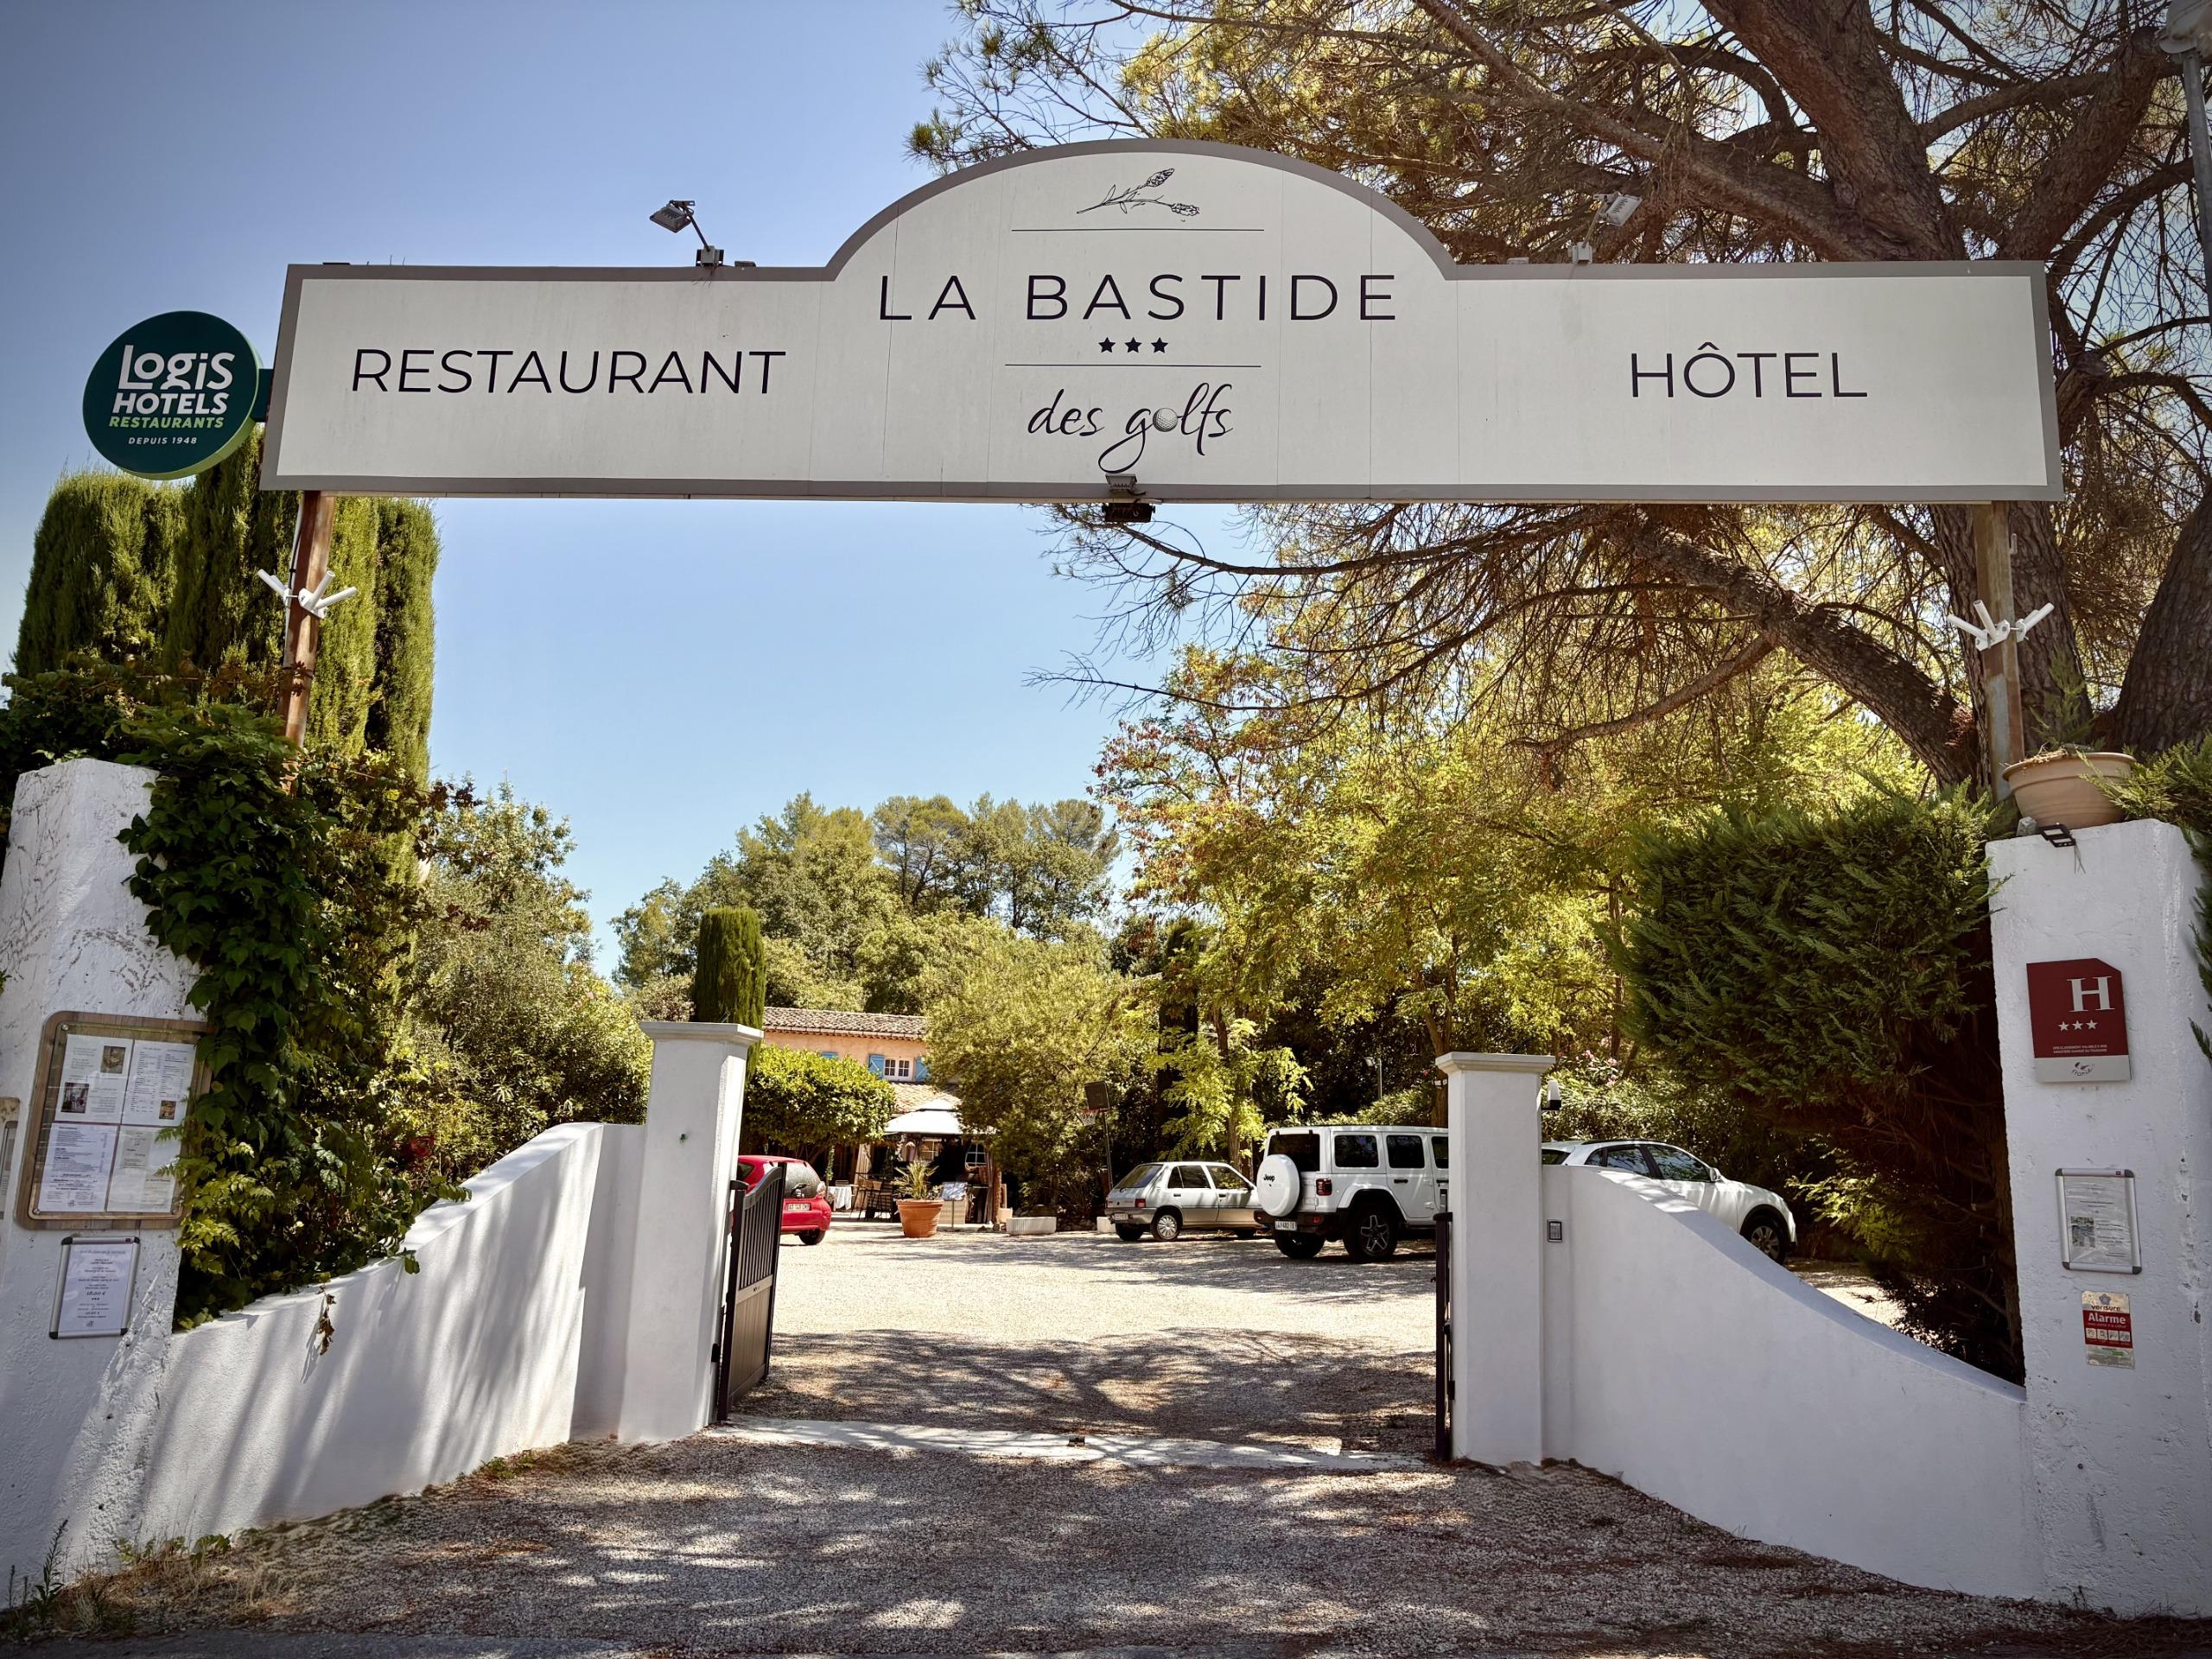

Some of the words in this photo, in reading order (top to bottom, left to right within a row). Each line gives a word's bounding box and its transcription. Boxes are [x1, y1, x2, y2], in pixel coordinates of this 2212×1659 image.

[880, 275, 976, 321] LA
[1027, 274, 1396, 321] BASTIDE
[118, 345, 235, 391] Logis
[352, 348, 787, 394] RESTAURANT
[1630, 341, 1868, 398] HÔTEL
[109, 416, 225, 429] RESTAURANTS
[112, 392, 230, 415] HOTELS
[128, 436, 168, 445] DEPUIS
[172, 436, 198, 445] 1948
[1027, 388, 1103, 437] des
[1097, 382, 1234, 474] golfs
[2066, 976, 2115, 1013] H
[2088, 1313, 2126, 1325] Alarme
